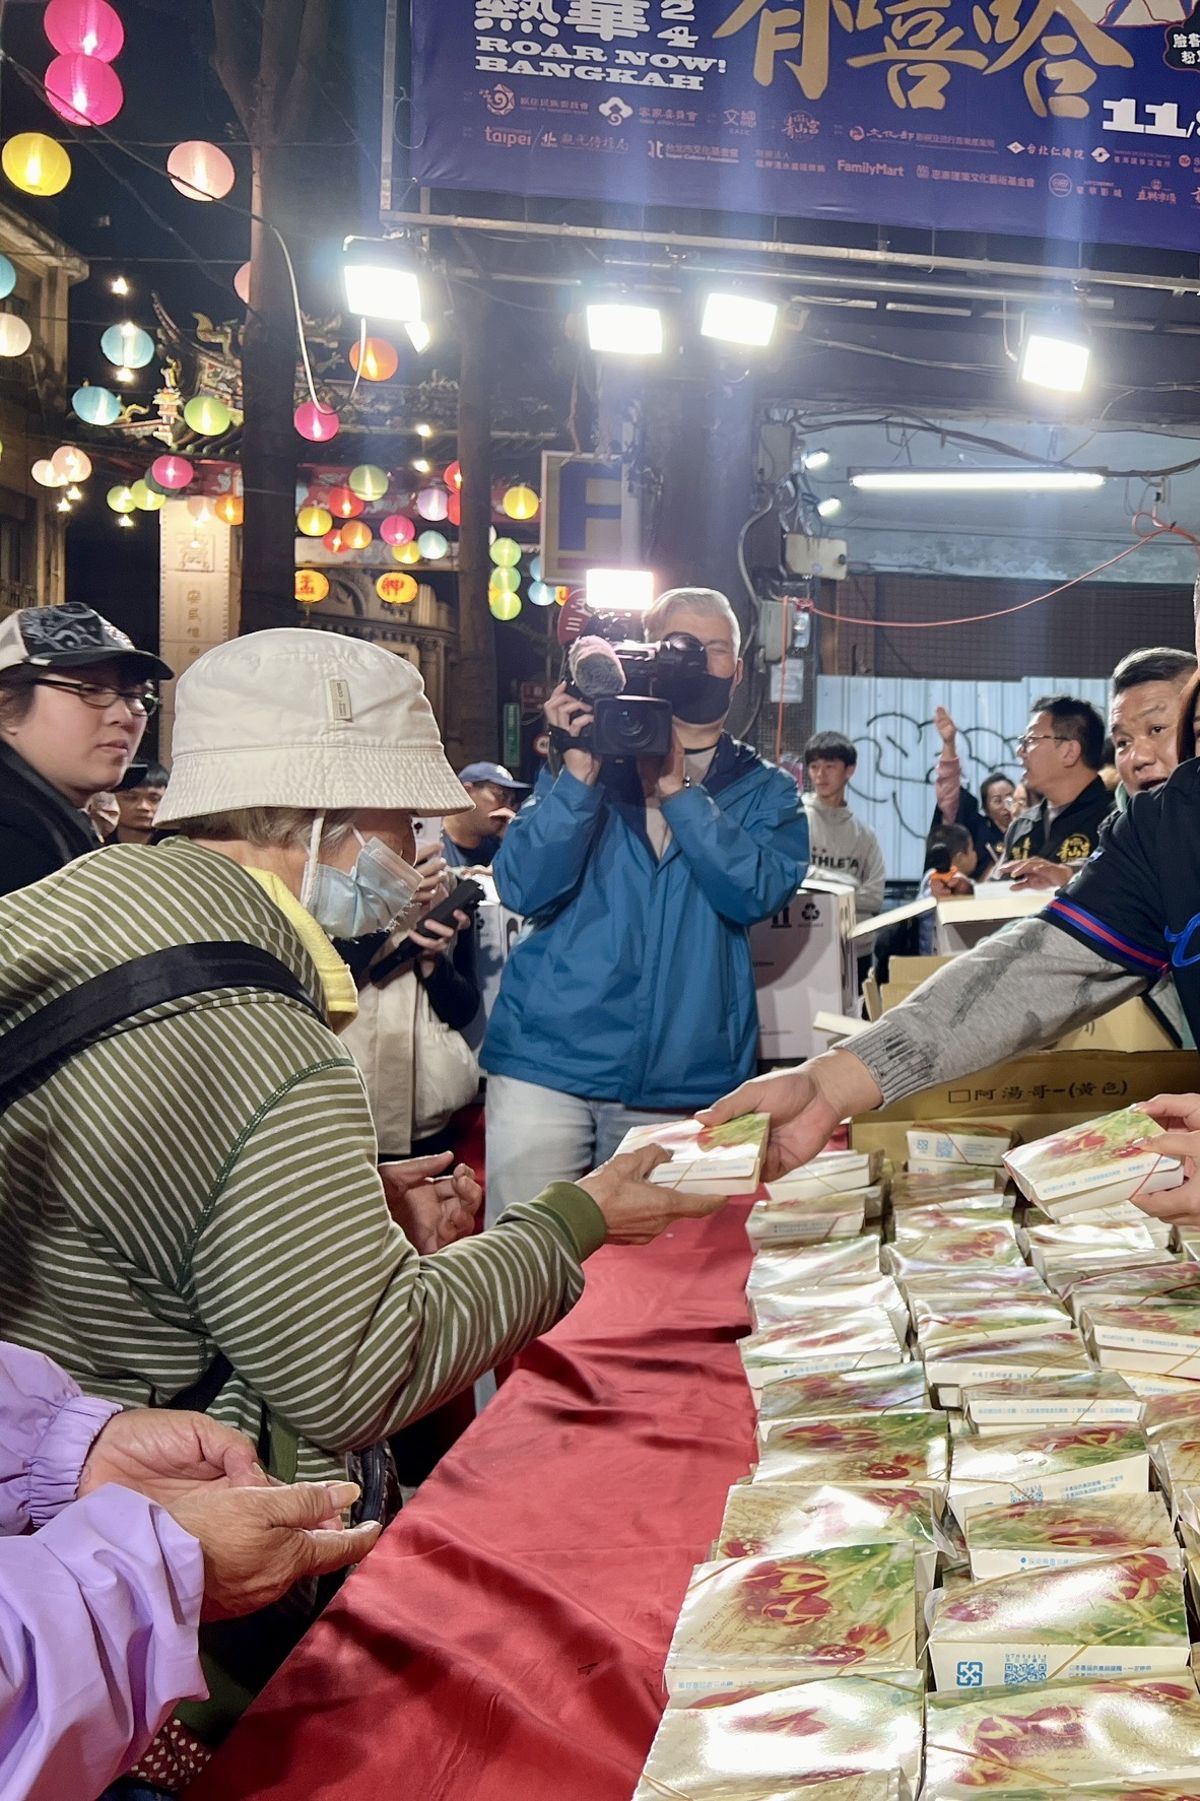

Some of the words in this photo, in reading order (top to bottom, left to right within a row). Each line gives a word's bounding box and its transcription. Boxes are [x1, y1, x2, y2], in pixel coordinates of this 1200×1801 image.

[1173, 33, 1200, 48] 臉書
[475, 36, 607, 61] ROAR
[615, 49, 726, 73] NOW!
[475, 56, 703, 90] BANGKAH
[485, 126, 531, 147] taipei
[837, 160, 904, 177] FamilyMart
